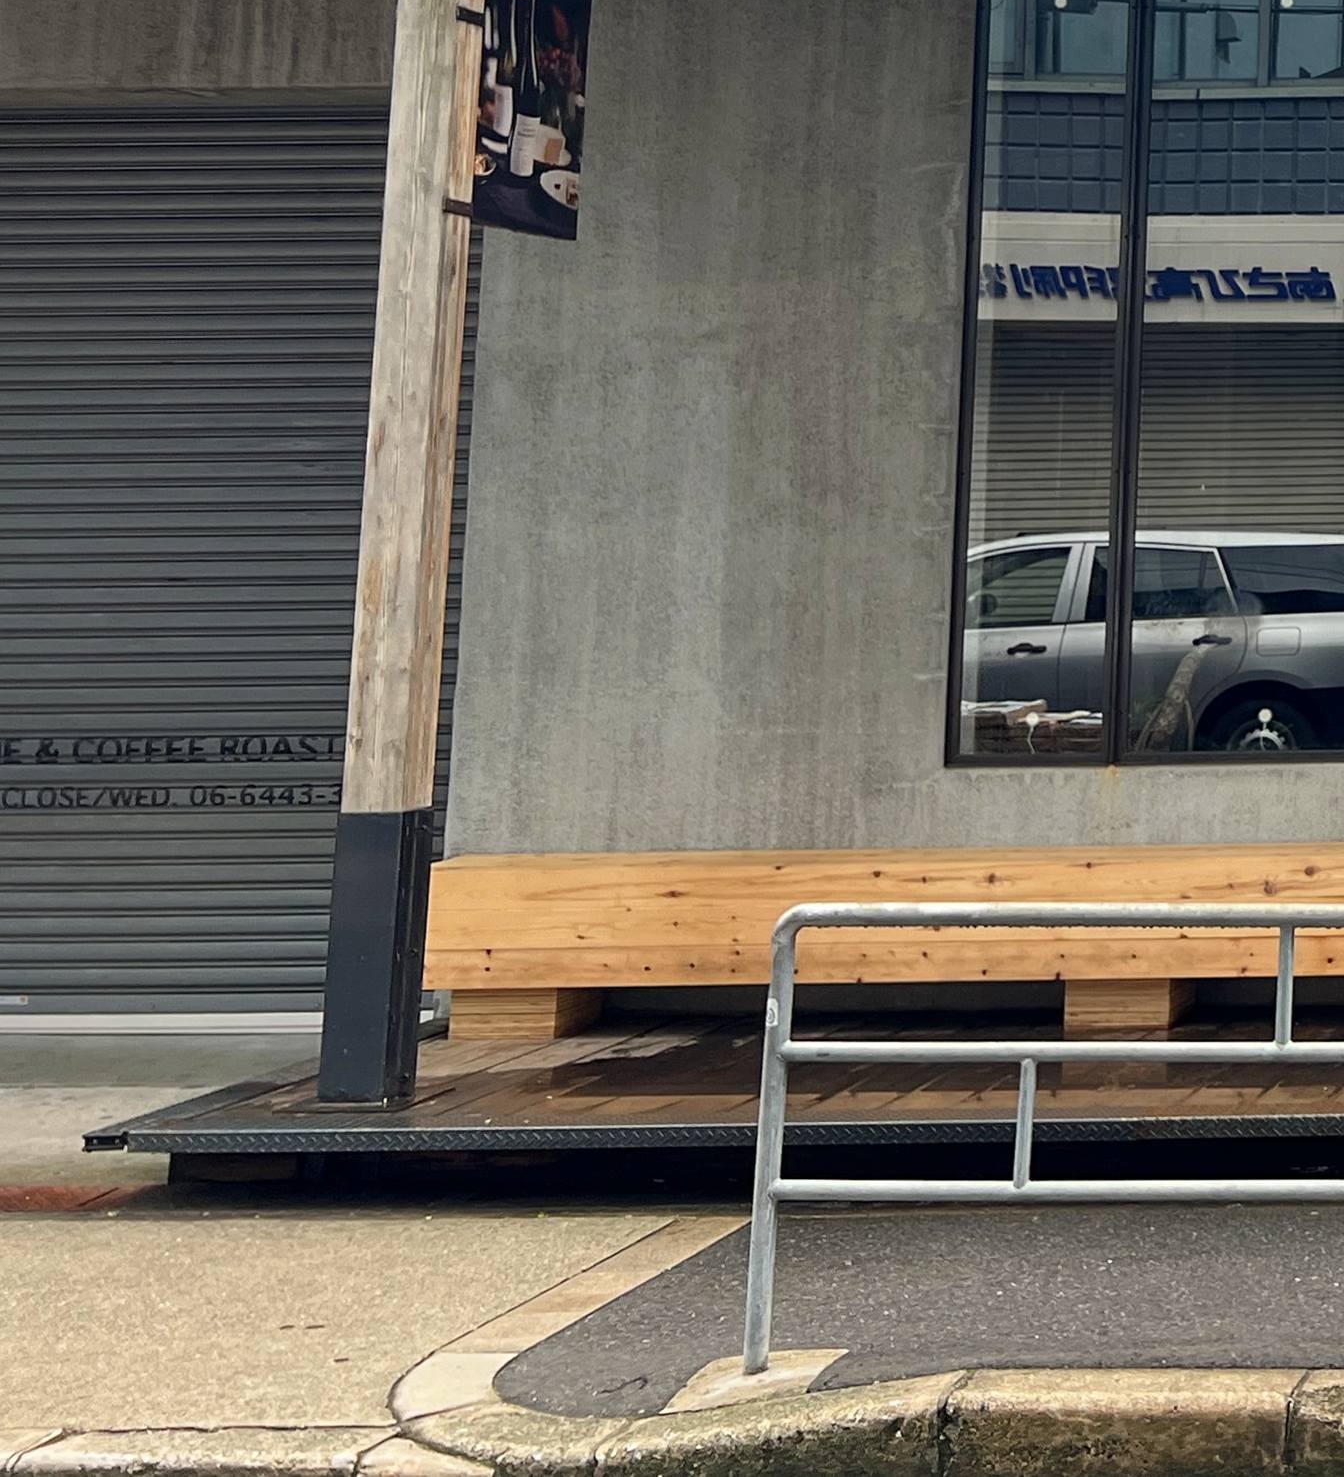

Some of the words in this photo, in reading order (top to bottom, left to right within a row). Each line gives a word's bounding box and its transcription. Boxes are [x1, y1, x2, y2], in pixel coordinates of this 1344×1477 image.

[0, 737, 23, 763] E
[36, 737, 60, 763] &
[72, 736, 206, 764] COFFEE
